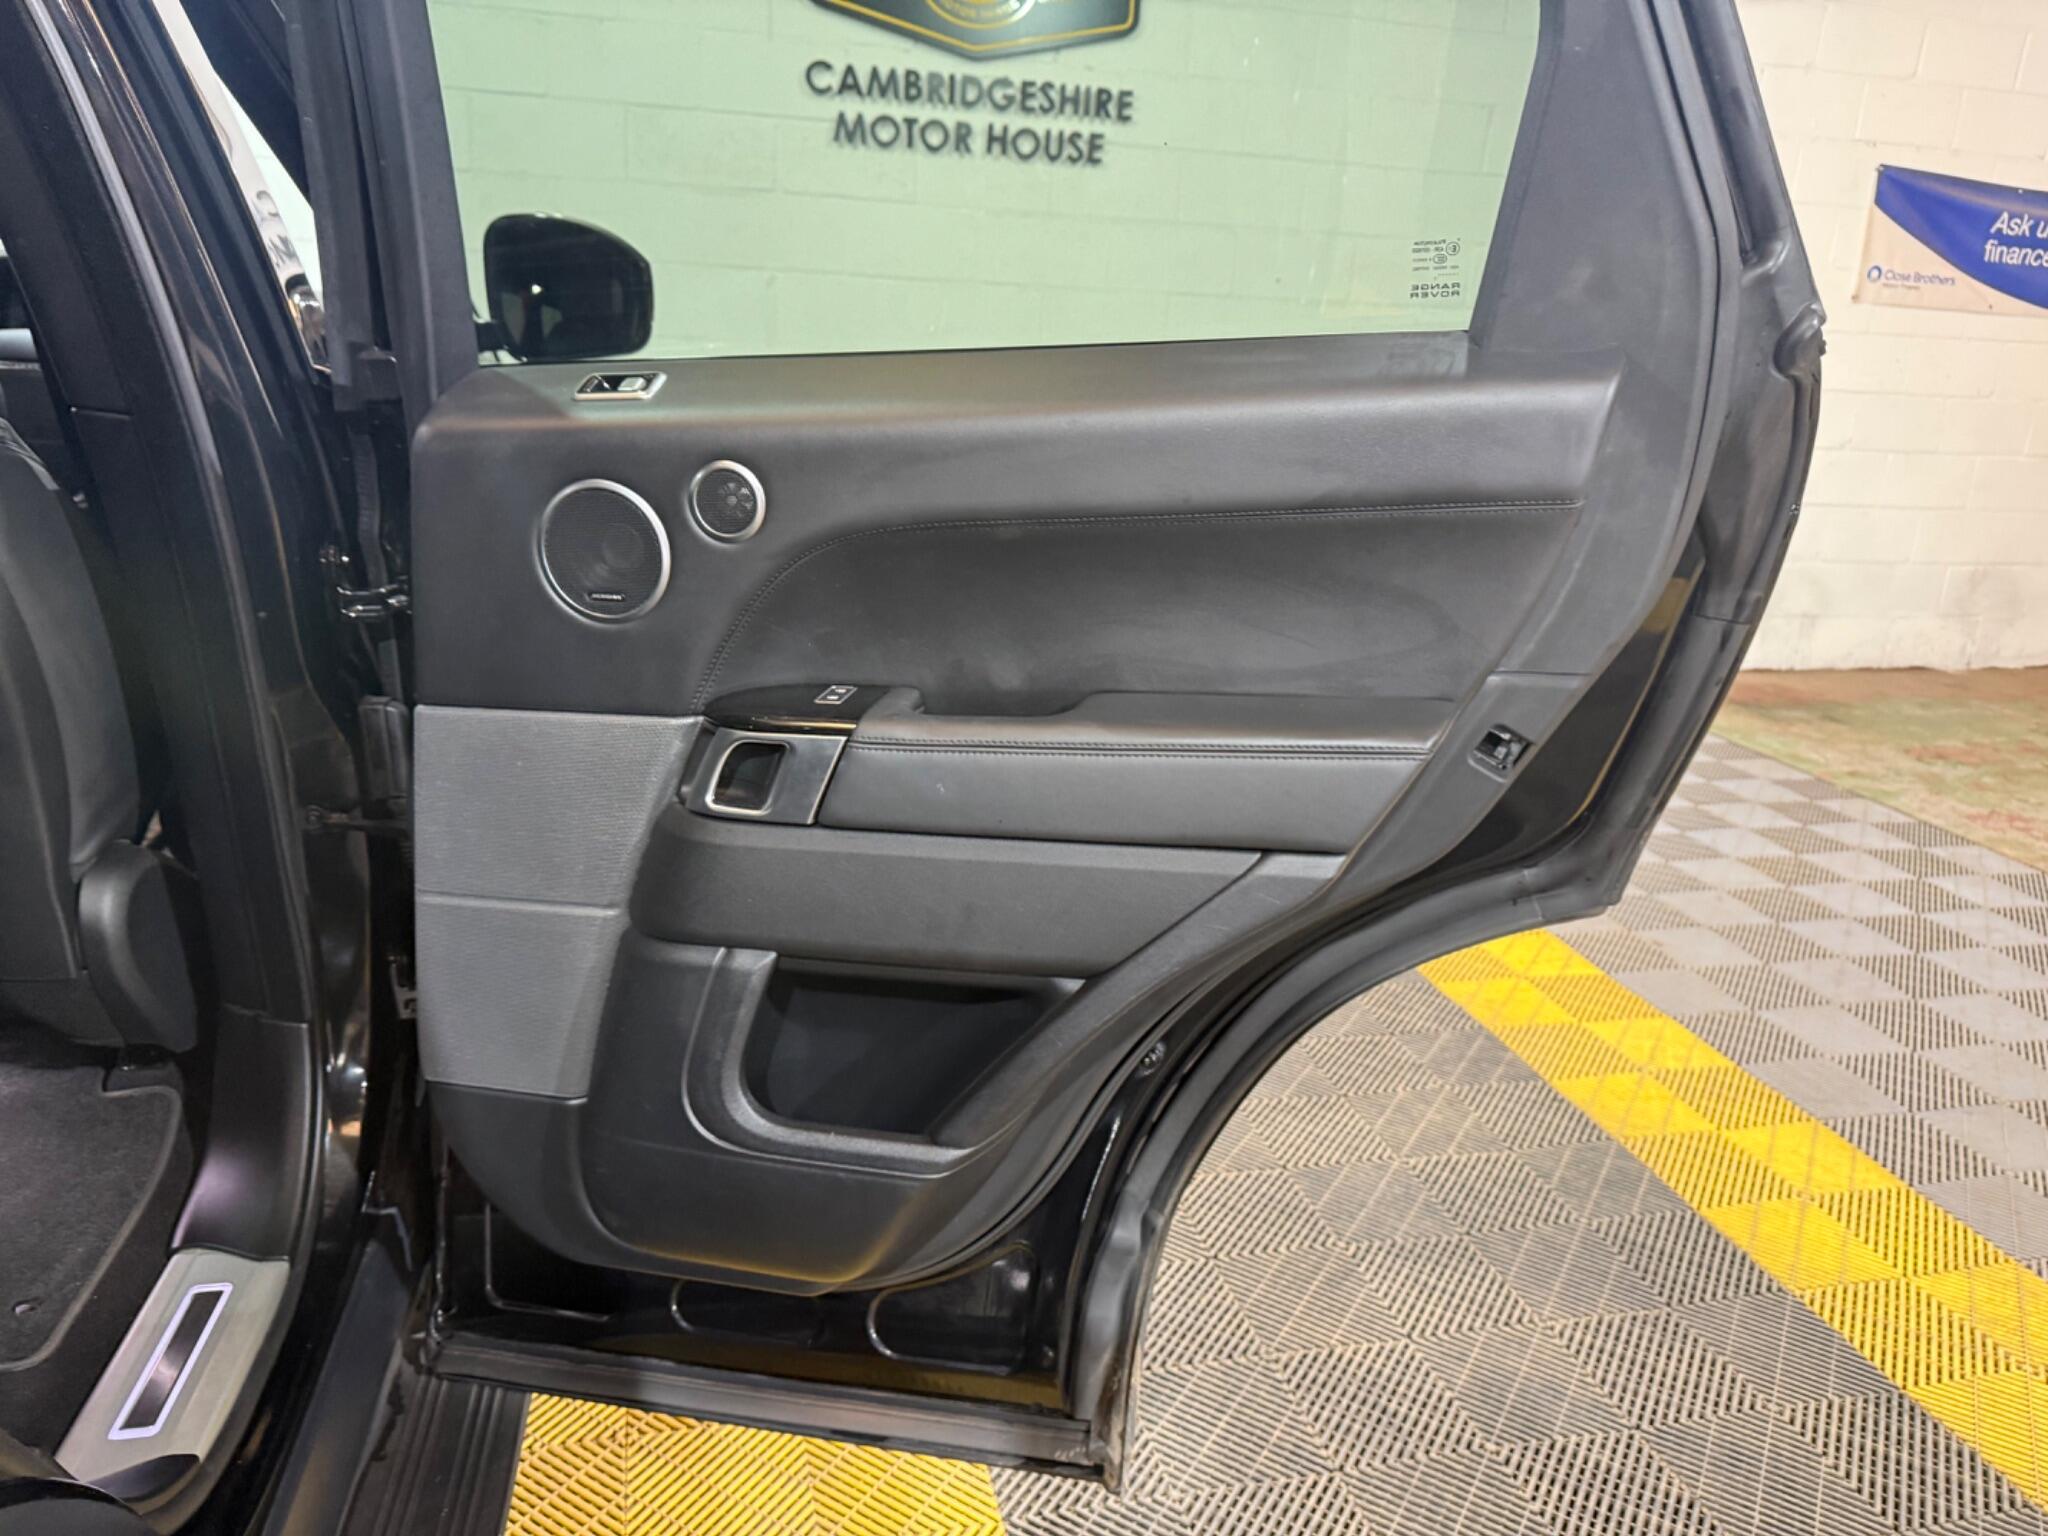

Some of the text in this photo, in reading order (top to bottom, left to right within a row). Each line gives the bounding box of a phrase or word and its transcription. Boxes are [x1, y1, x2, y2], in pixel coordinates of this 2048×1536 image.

[805, 60, 1135, 123] CAMBRIDGESHIRE
[832, 111, 1106, 166] MOTOR HOUSE
[1990, 211, 2034, 237] Ask
